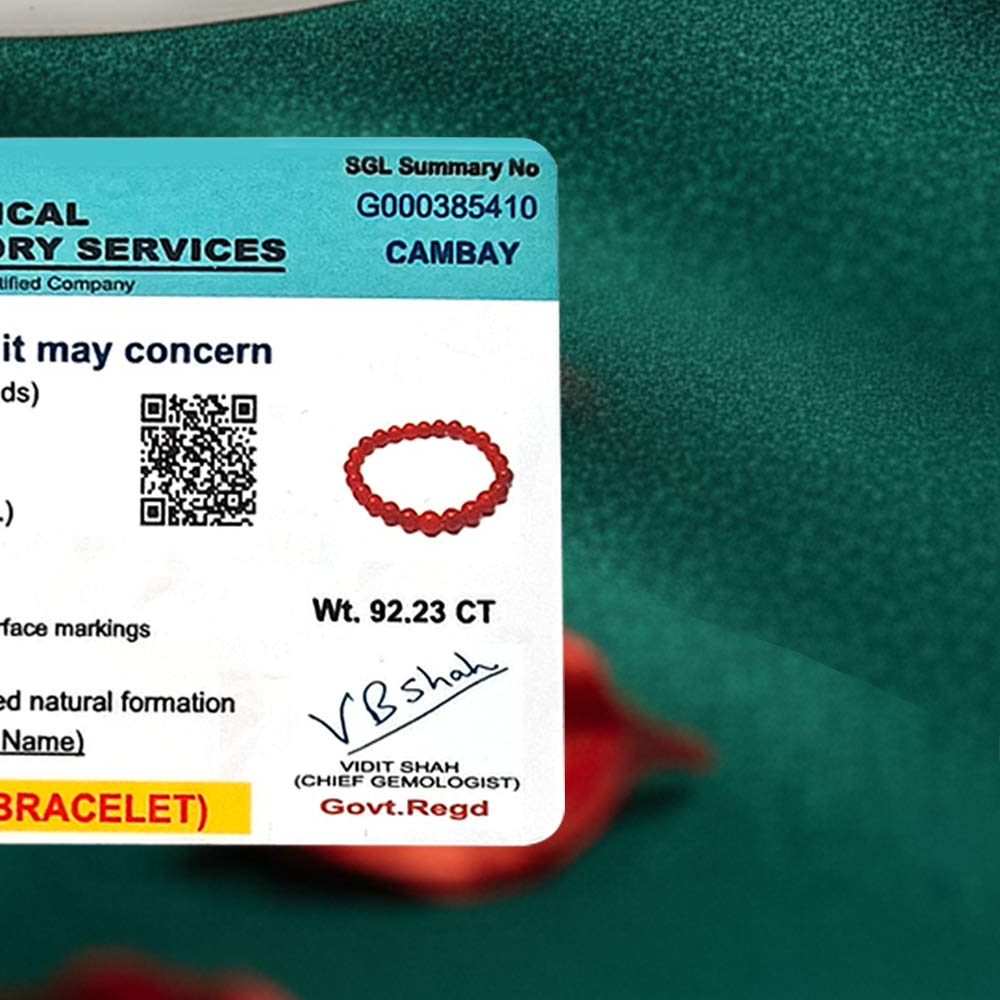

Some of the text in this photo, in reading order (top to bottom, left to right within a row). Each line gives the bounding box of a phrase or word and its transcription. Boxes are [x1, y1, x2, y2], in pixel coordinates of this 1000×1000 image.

[345, 155, 540, 182] SGL Summary No
[356, 191, 538, 220] G000385410
[76, 236, 287, 263] SERVICES
[385, 239, 521, 266] CAMBAY
[46, 274, 136, 295] Company
[3, 333, 26, 363] it
[37, 341, 113, 372] may
[124, 342, 272, 365] concern
[312, 597, 497, 624] Wt. 92.23 CT
[54, 618, 151, 643] markings
[29, 690, 113, 713] natural
[120, 690, 236, 714] formation
[2, 731, 85, 756] Name)
[339, 760, 460, 774] VIDIT SHAH
[294, 774, 521, 792] (CHIEF GEMOLOGIST)
[320, 798, 489, 821] Govt.Regd
